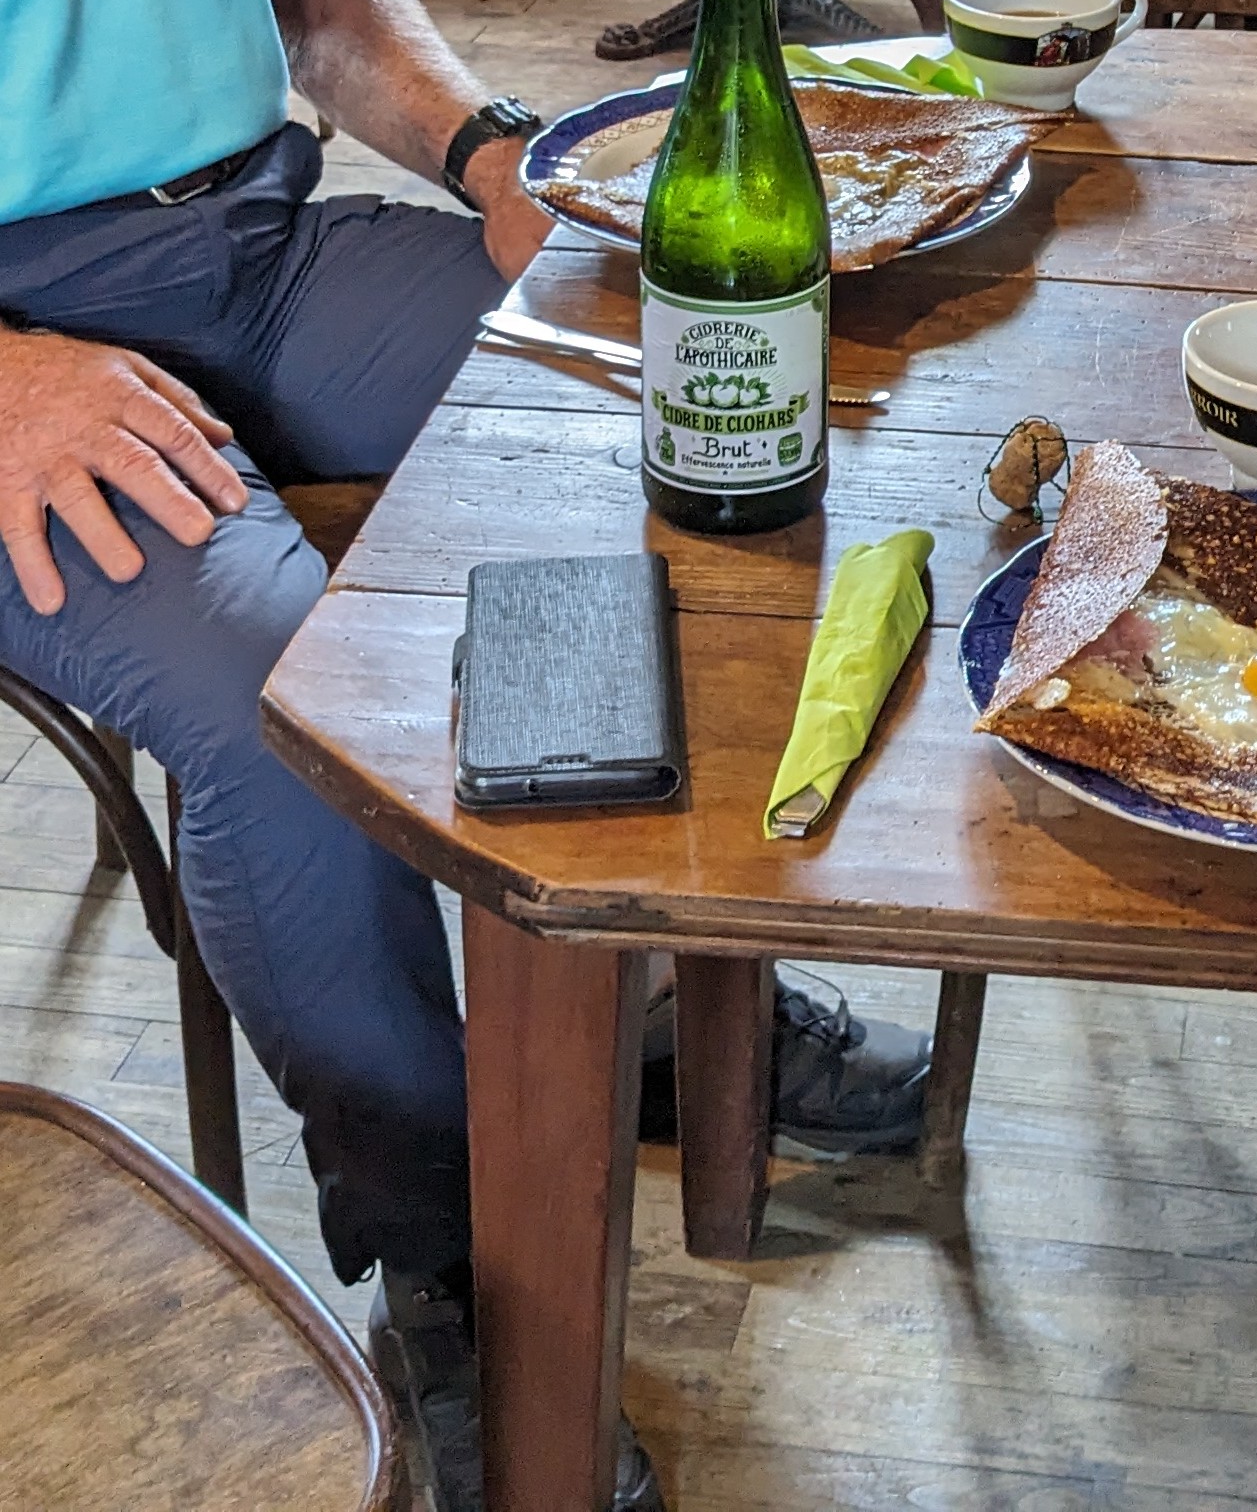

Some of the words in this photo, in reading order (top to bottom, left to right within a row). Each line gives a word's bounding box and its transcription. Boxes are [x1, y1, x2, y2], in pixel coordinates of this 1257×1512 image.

[689, 321, 760, 341] CIDRERIE
[715, 337, 734, 350] DE
[675, 344, 778, 367] L'APOTHICAIRE
[662, 403, 700, 429] CIDRE
[704, 416, 723, 432] DE
[727, 408, 795, 432] CLOHARS
[692, 437, 753, 458] Brut
[681, 454, 735, 469] Effervescence
[737, 457, 772, 469] naturelle
